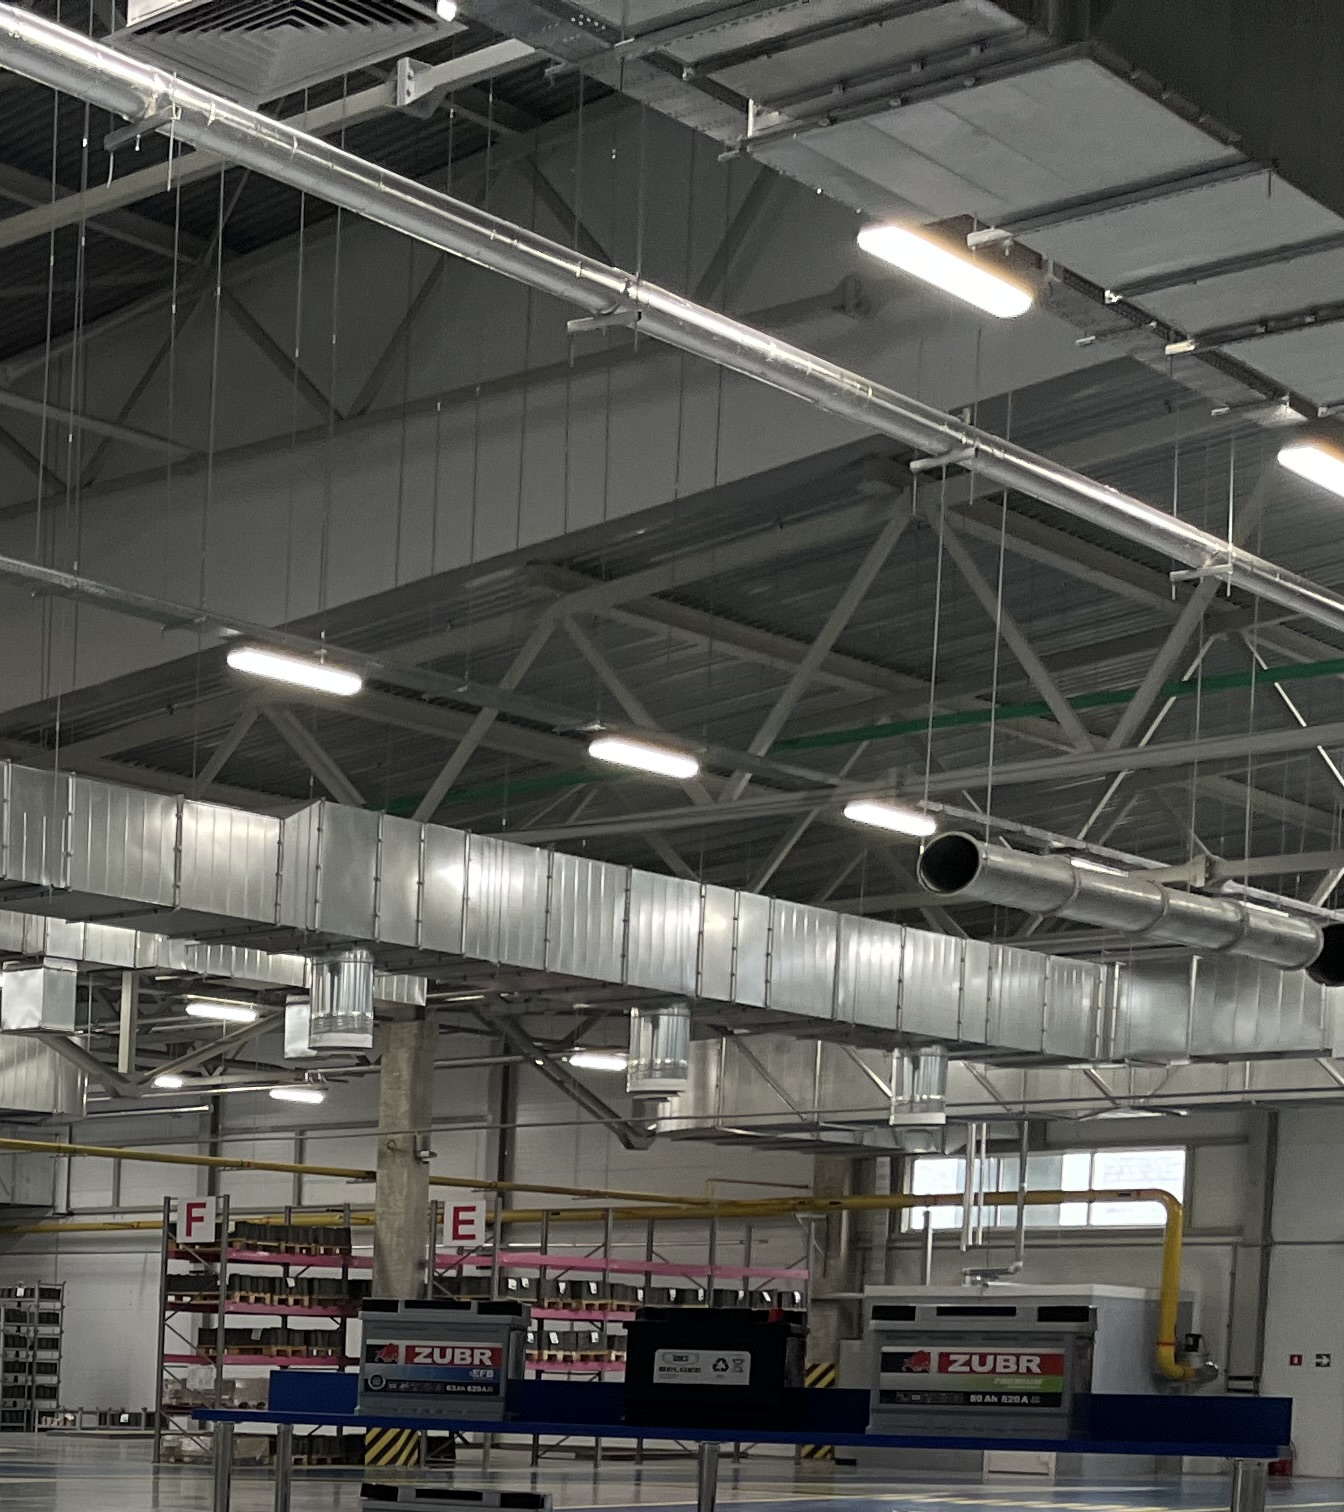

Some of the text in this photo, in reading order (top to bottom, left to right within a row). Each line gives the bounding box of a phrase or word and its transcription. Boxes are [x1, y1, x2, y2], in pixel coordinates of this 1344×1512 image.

[186, 1202, 207, 1237] F
[452, 1205, 477, 1240] E
[413, 1347, 493, 1366] ZUBR
[947, 1354, 1042, 1374] ZUBR
